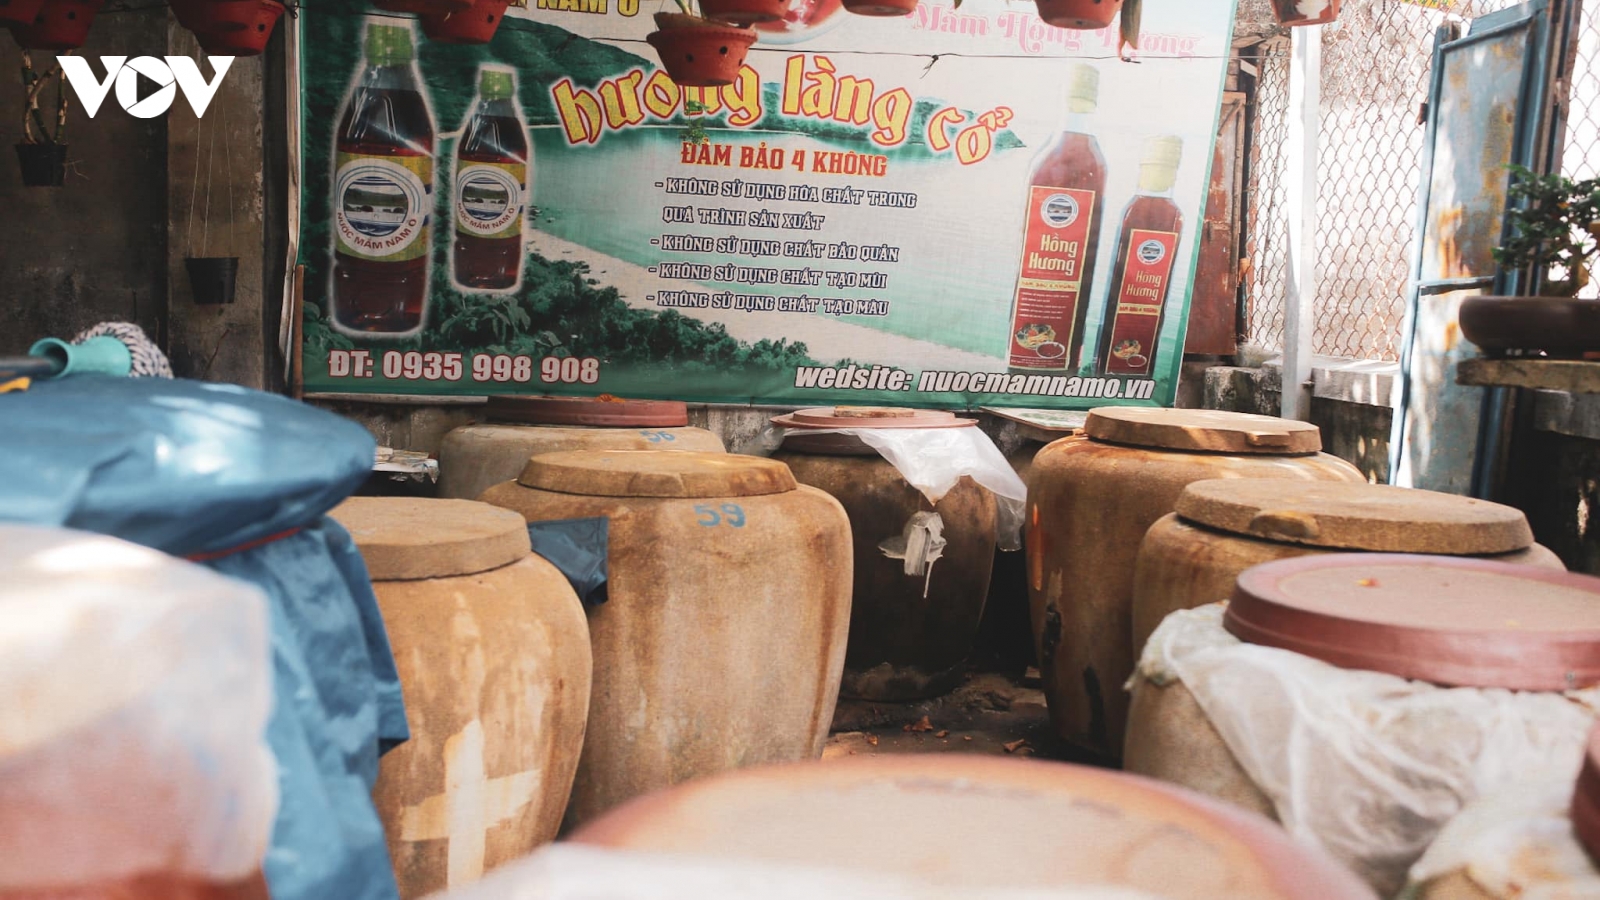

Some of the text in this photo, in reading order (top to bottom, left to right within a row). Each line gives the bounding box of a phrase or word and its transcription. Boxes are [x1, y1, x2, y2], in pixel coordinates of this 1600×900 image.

[782, 54, 912, 146] làng
[740, 142, 783, 171] BẢO
[791, 150, 805, 172] 4
[812, 150, 888, 177] KHÔNG
[666, 177, 718, 196] KHÔNG
[721, 179, 743, 197] SỬ
[744, 183, 786, 201] DỤNG
[789, 185, 818, 202] HÓA
[868, 190, 917, 208] TRONG
[492, 215, 511, 228] NAM
[663, 206, 694, 223] QUÁ
[698, 208, 746, 226] TRÌNH
[749, 209, 780, 228] SẢN
[385, 228, 412, 247] NAM
[662, 235, 714, 252] KHÔNG
[717, 236, 738, 253] SỬ
[740, 240, 780, 257] DỤNG
[828, 242, 858, 260] BẢO
[860, 244, 899, 262] QUẢN
[1040, 232, 1078, 258] Hồng
[660, 262, 711, 280] KHÔNG
[714, 263, 735, 281] SỬ
[737, 267, 778, 285] DỤNG
[826, 272, 857, 289] TẠO
[859, 272, 887, 288] MÙI
[1028, 251, 1076, 276] Hương
[657, 290, 709, 308] KHÔNG
[712, 291, 733, 308] SỬ
[734, 295, 775, 312] DỤNG
[823, 299, 853, 316] TẠO
[856, 299, 889, 315] MÀU
[1126, 284, 1159, 301] Hương
[329, 349, 600, 384] ĐT: 0935 998 908
[795, 364, 1156, 400] wedsite: nuocmamnamo.vn
[640, 431, 675, 443] 56
[694, 502, 746, 528] 59
